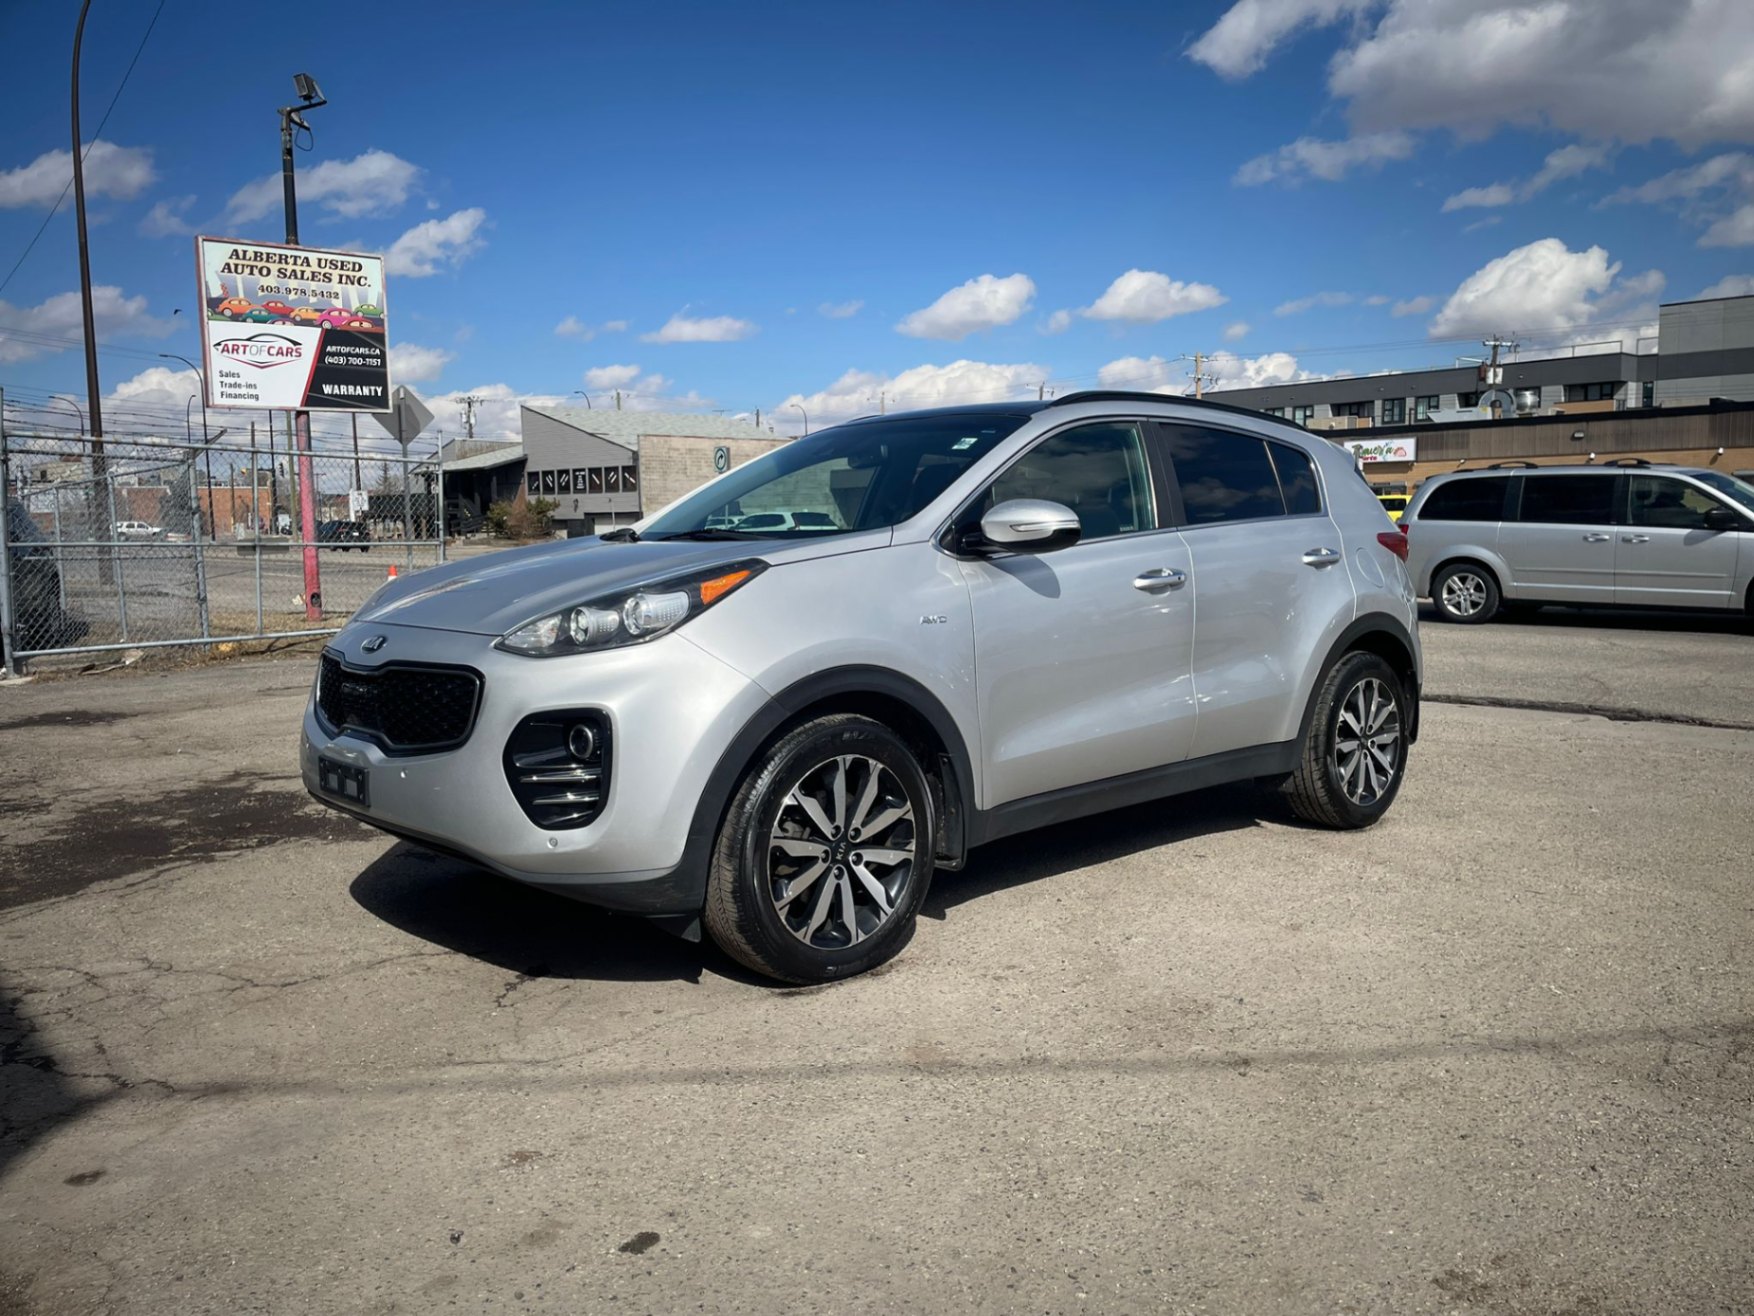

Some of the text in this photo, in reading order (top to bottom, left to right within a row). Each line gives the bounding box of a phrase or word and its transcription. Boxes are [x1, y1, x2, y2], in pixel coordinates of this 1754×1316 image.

[228, 249, 363, 273] ALBERTA USED
[220, 262, 371, 287] AUTO SALES INC.
[258, 284, 340, 300] 403.978.5432
[326, 345, 381, 355] ARTOFCARS.CA
[325, 355, 381, 366] (403) 700-1151
[219, 370, 240, 378] Sales
[219, 381, 257, 389] Trade-ins
[322, 384, 383, 396] WARRANTY
[220, 391, 260, 401] Financing
